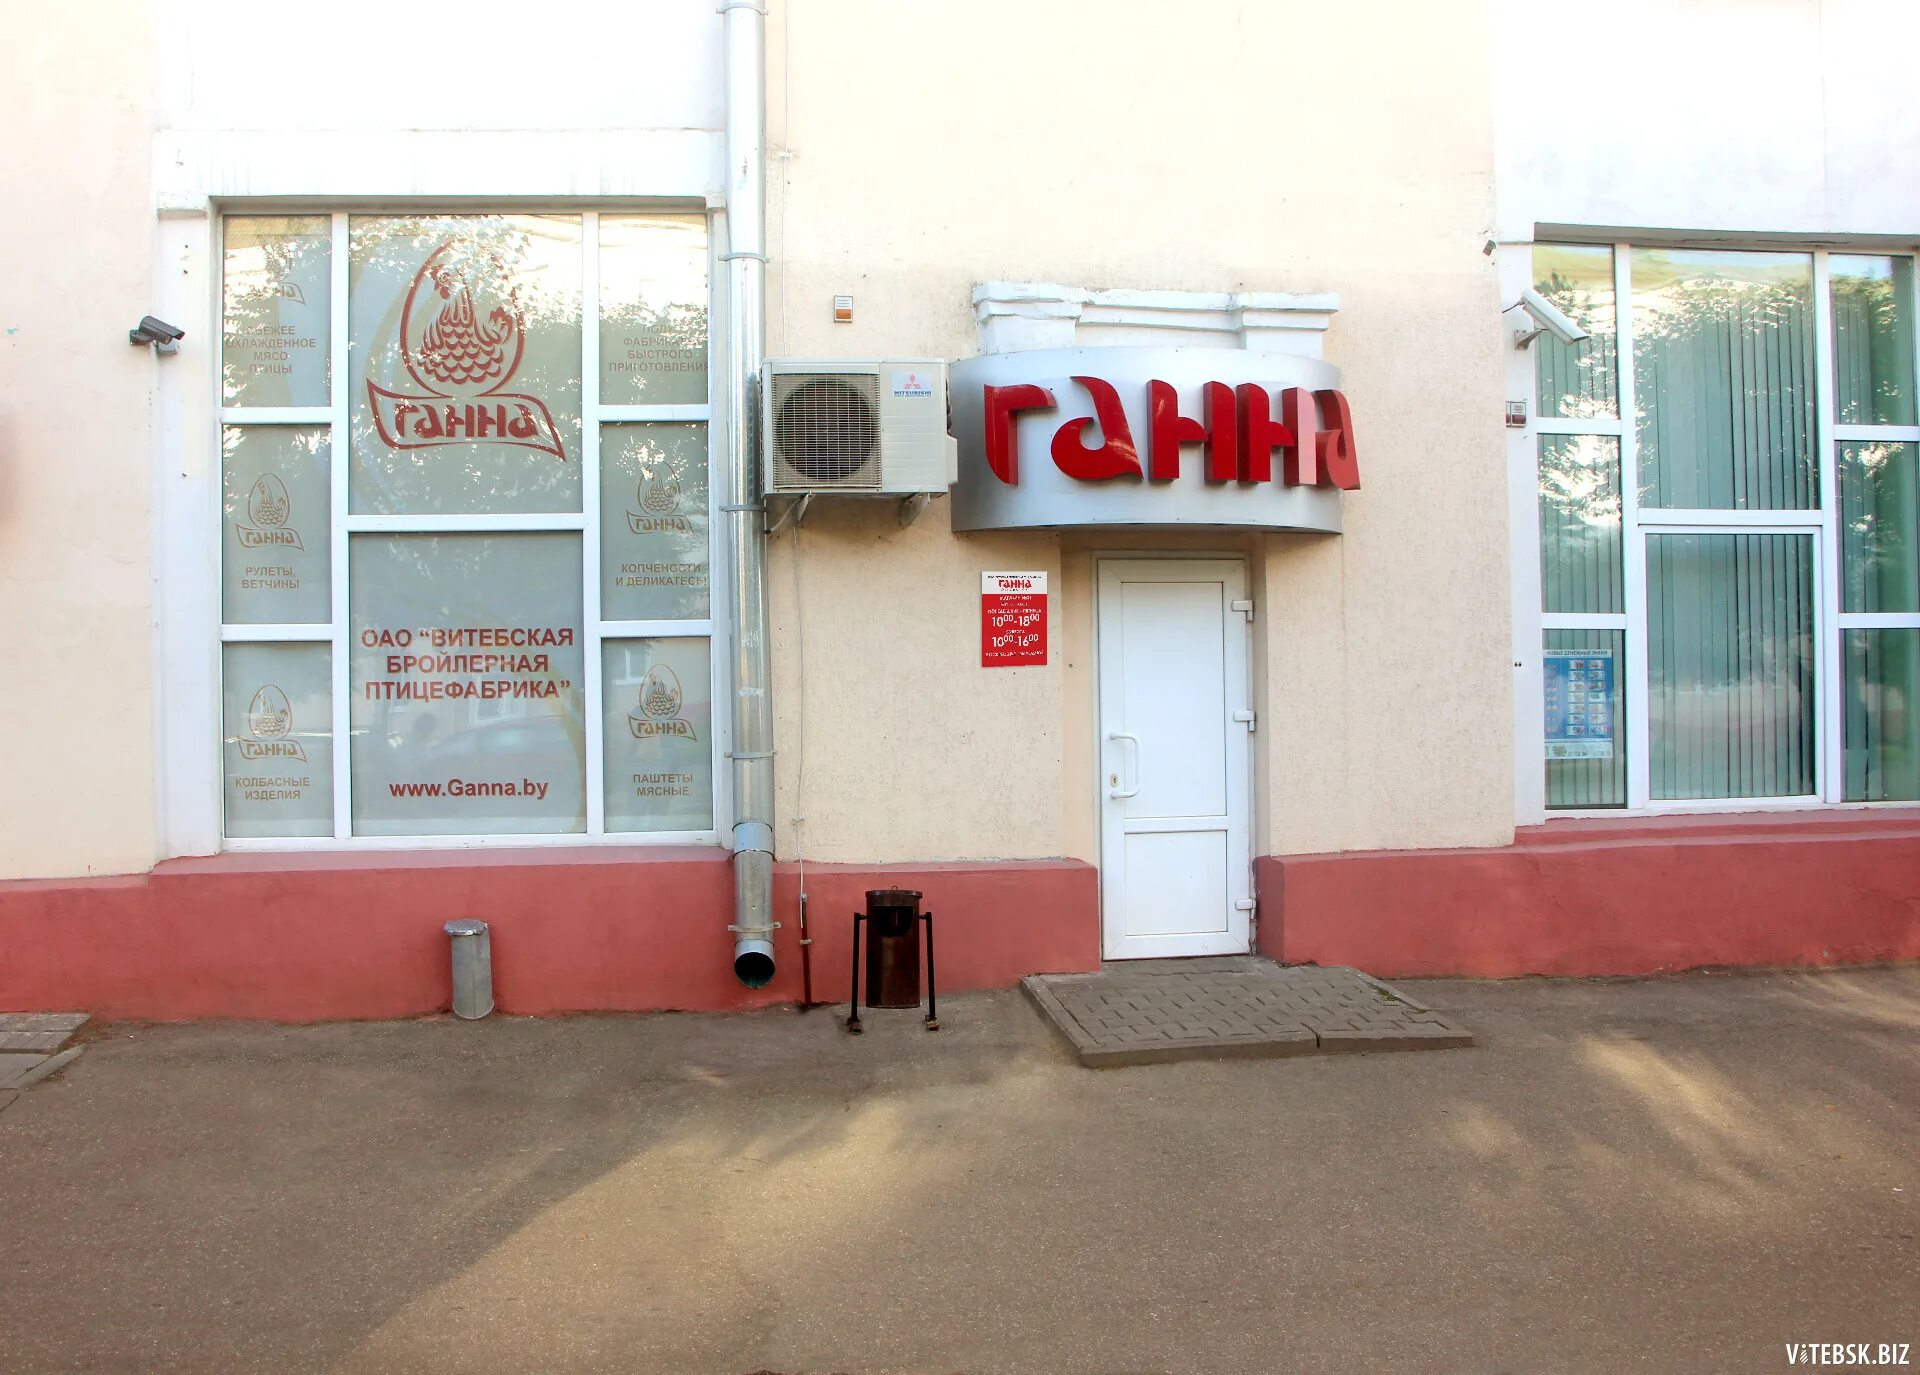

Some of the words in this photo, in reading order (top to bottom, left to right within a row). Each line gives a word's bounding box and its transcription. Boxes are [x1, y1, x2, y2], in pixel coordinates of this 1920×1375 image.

[225, 338, 317, 349] ОХЛАЖДЕННОЕ
[254, 352, 289, 361] МЯСО
[628, 350, 694, 360] БЫСТРОГО
[249, 364, 292, 375] ПТИЦЫ
[621, 563, 702, 573] КОПЧЕНОСТИ
[242, 578, 300, 590] ВЕТЧИНЫ
[615, 576, 624, 586] И
[360, 628, 413, 648] ОАО
[386, 651, 550, 674] БРОЙЛЕРНАЯ
[235, 777, 310, 788] КОЛБАСНЫЕ
[632, 773, 693, 784] ПАШТЕТЫ
[389, 778, 549, 800] www.Ganna.by
[636, 786, 690, 796] МЯСНЫЕ
[244, 790, 301, 801] ИЗДЕЛИЯ
